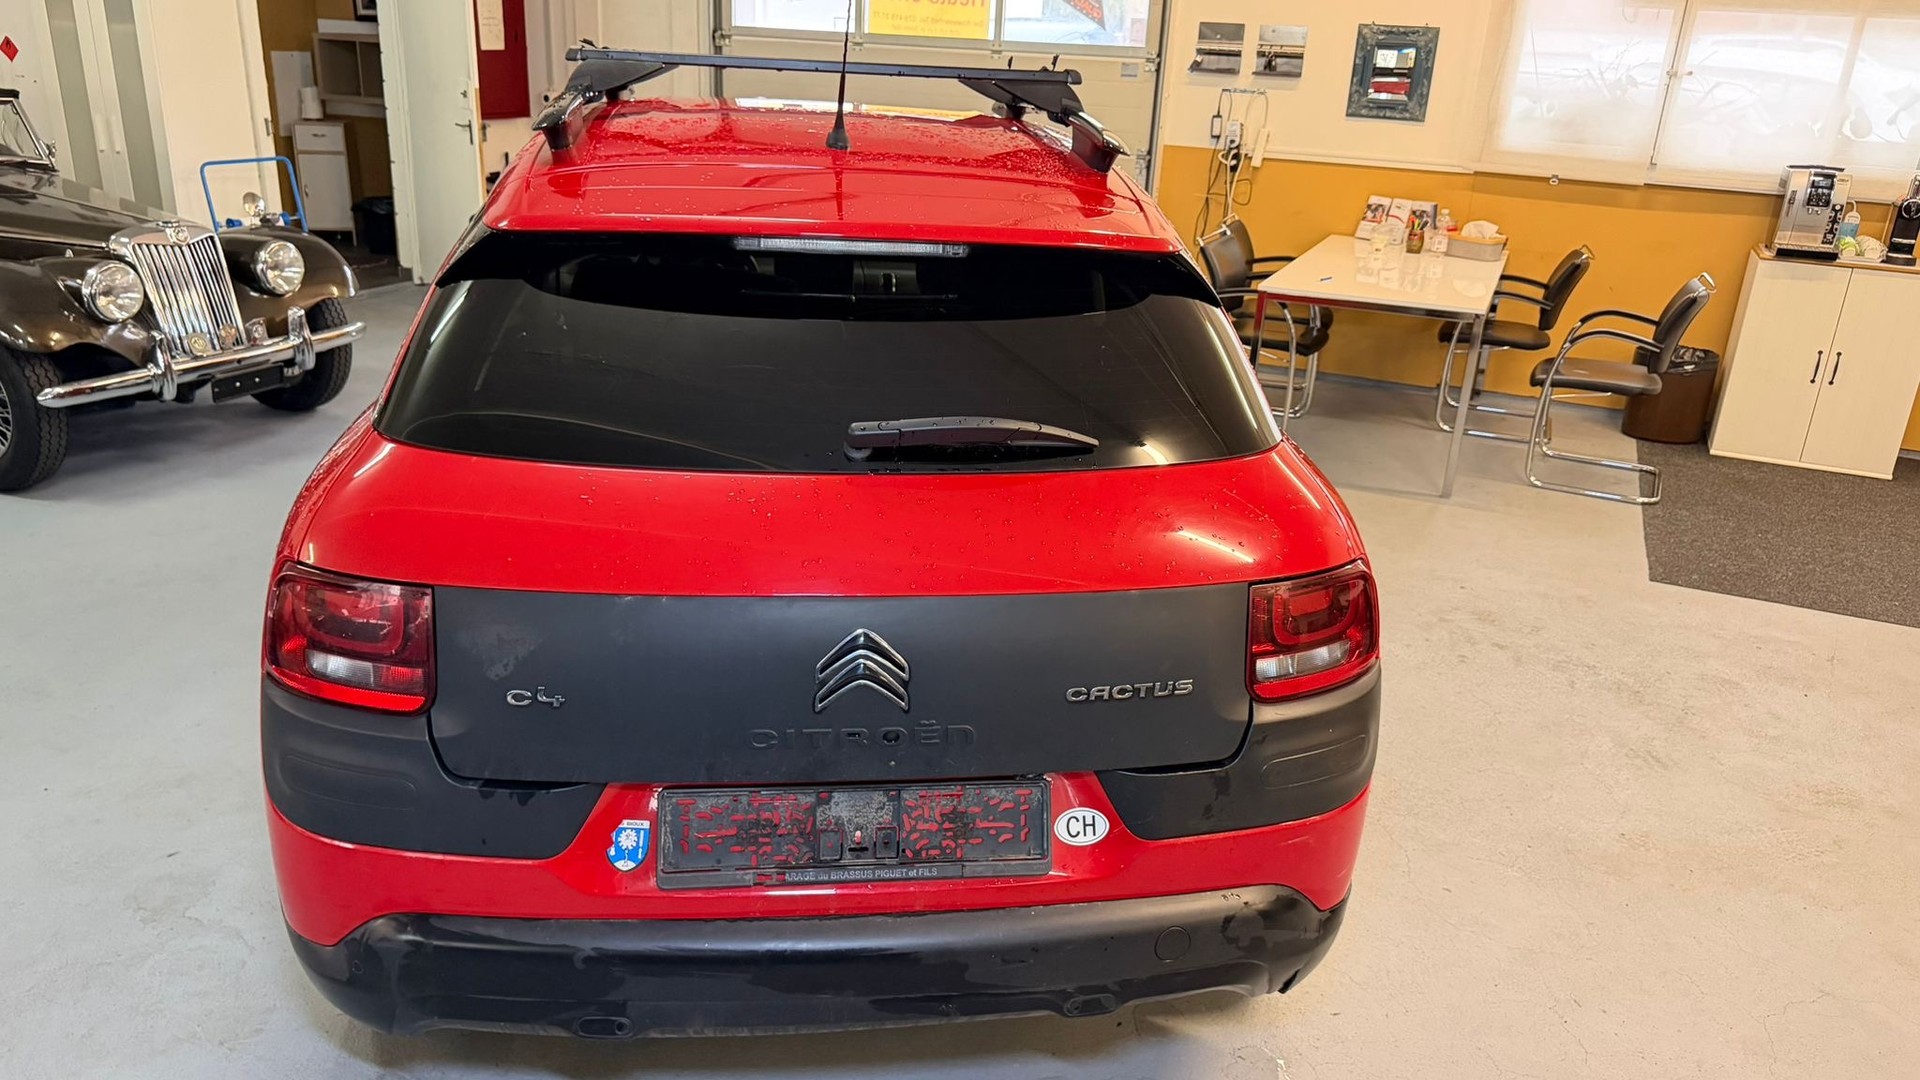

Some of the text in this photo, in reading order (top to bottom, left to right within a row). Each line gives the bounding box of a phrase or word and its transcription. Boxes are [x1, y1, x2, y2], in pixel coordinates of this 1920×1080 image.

[506, 686, 566, 707] C4
[1066, 679, 1193, 702] CACTUS
[750, 719, 976, 748] CITROËN
[1066, 815, 1096, 838] CH
[785, 871, 816, 881] ARAGE
[817, 872, 829, 880] du
[830, 869, 873, 880] BRASSUS
[874, 868, 907, 878] PIGUET
[918, 867, 938, 876] FILS
